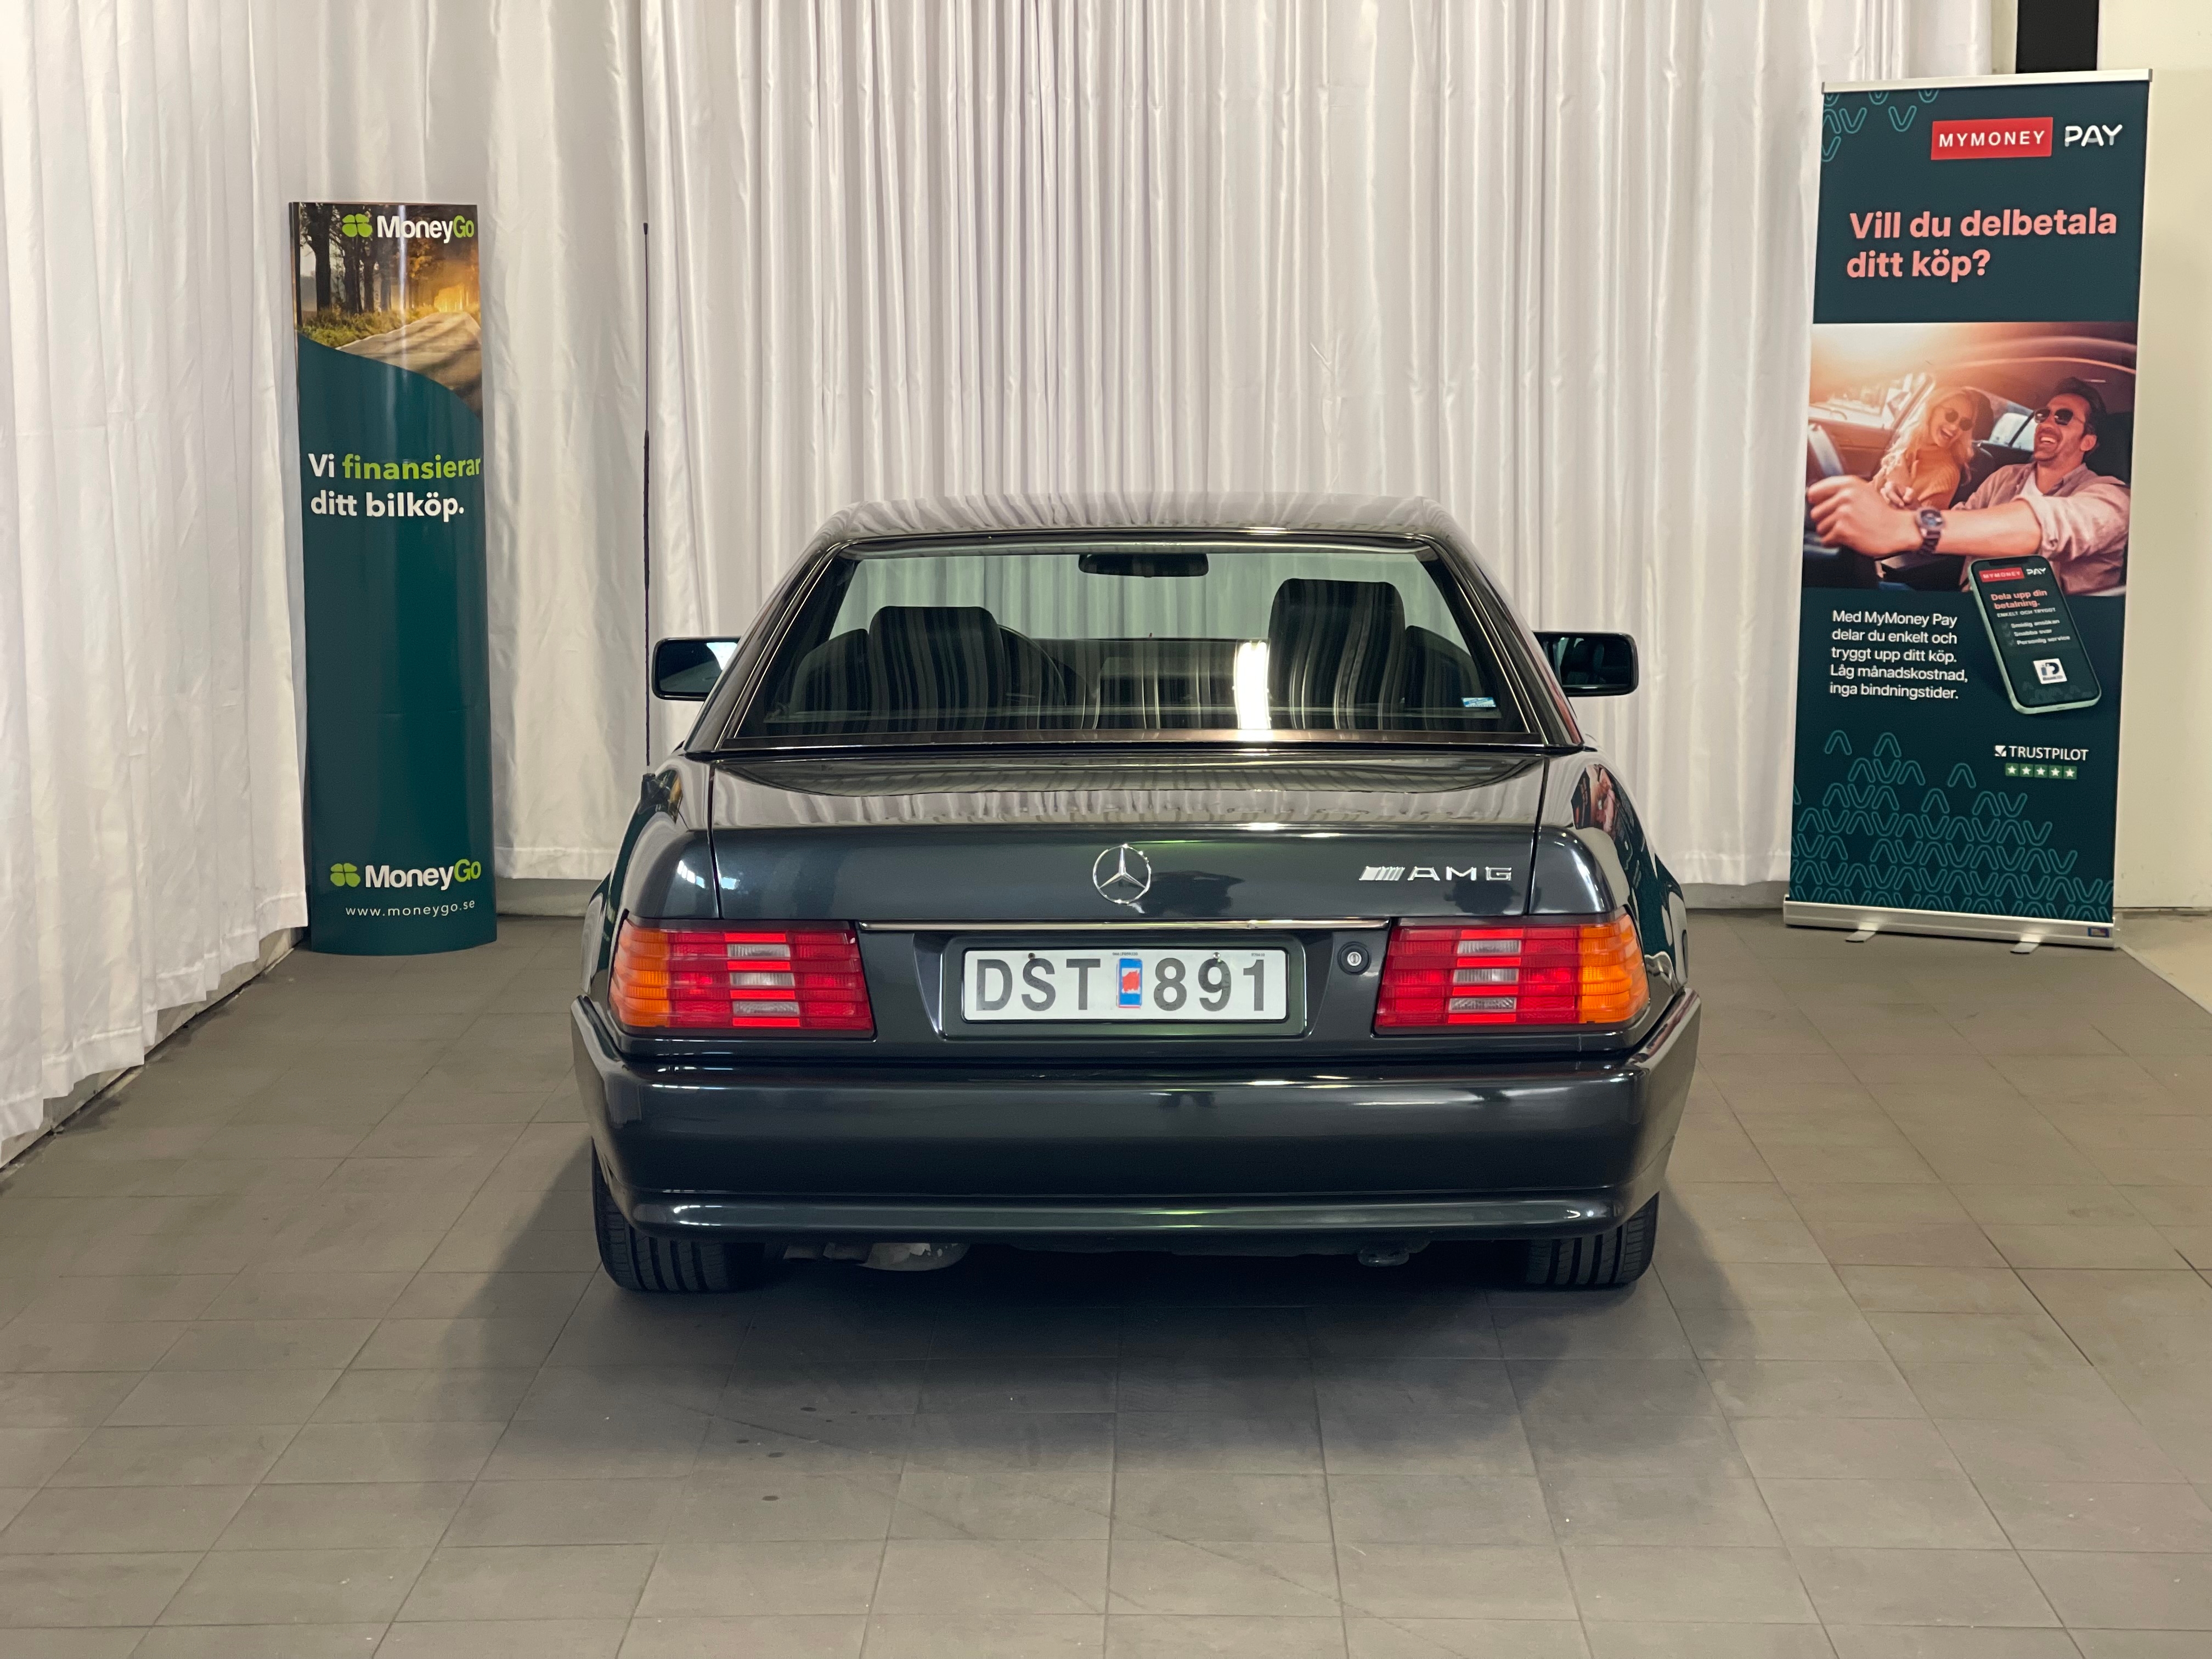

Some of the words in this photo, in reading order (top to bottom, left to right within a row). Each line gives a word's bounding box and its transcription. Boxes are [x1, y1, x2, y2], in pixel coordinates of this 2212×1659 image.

[1939, 130, 2046, 148] MYMONEY
[2064, 124, 2123, 147] PAY
[376, 215, 475, 244] MoneyGo
[1849, 211, 1901, 239] Vill
[1909, 211, 1951, 238] du
[1960, 207, 2118, 236] delbetala
[1846, 251, 1903, 278] ditt
[1912, 249, 1991, 283] köp?
[308, 453, 335, 478] Vi
[342, 454, 481, 479] finansierar
[311, 490, 357, 516] ditt
[366, 492, 465, 522] bilköp.
[1982, 571, 2021, 579] MYMONEY
[1832, 610, 1861, 623] Med
[1865, 611, 1929, 628] MyMoney
[1932, 613, 1958, 628] Pay
[1831, 628, 1865, 641] delar
[1867, 630, 1885, 641] du
[1888, 631, 1928, 643] enkelt
[1931, 632, 1957, 644] och
[1831, 647, 1871, 662] tryggt
[1874, 650, 1900, 663] upp
[1903, 649, 1925, 662] ditt
[1928, 650, 1957, 665] köp.
[1830, 664, 1854, 680] Låg
[1858, 665, 1968, 683] månadskostnad,
[1830, 681, 1858, 697] inga
[1861, 683, 1959, 701] bindningstider.
[2009, 746, 2089, 761] TRUSTPILOT
[365, 859, 481, 890] MoneyGo
[346, 900, 475, 917] www.moneygo.se
[975, 957, 1101, 1012] DST
[1155, 958, 1265, 1012] 891
